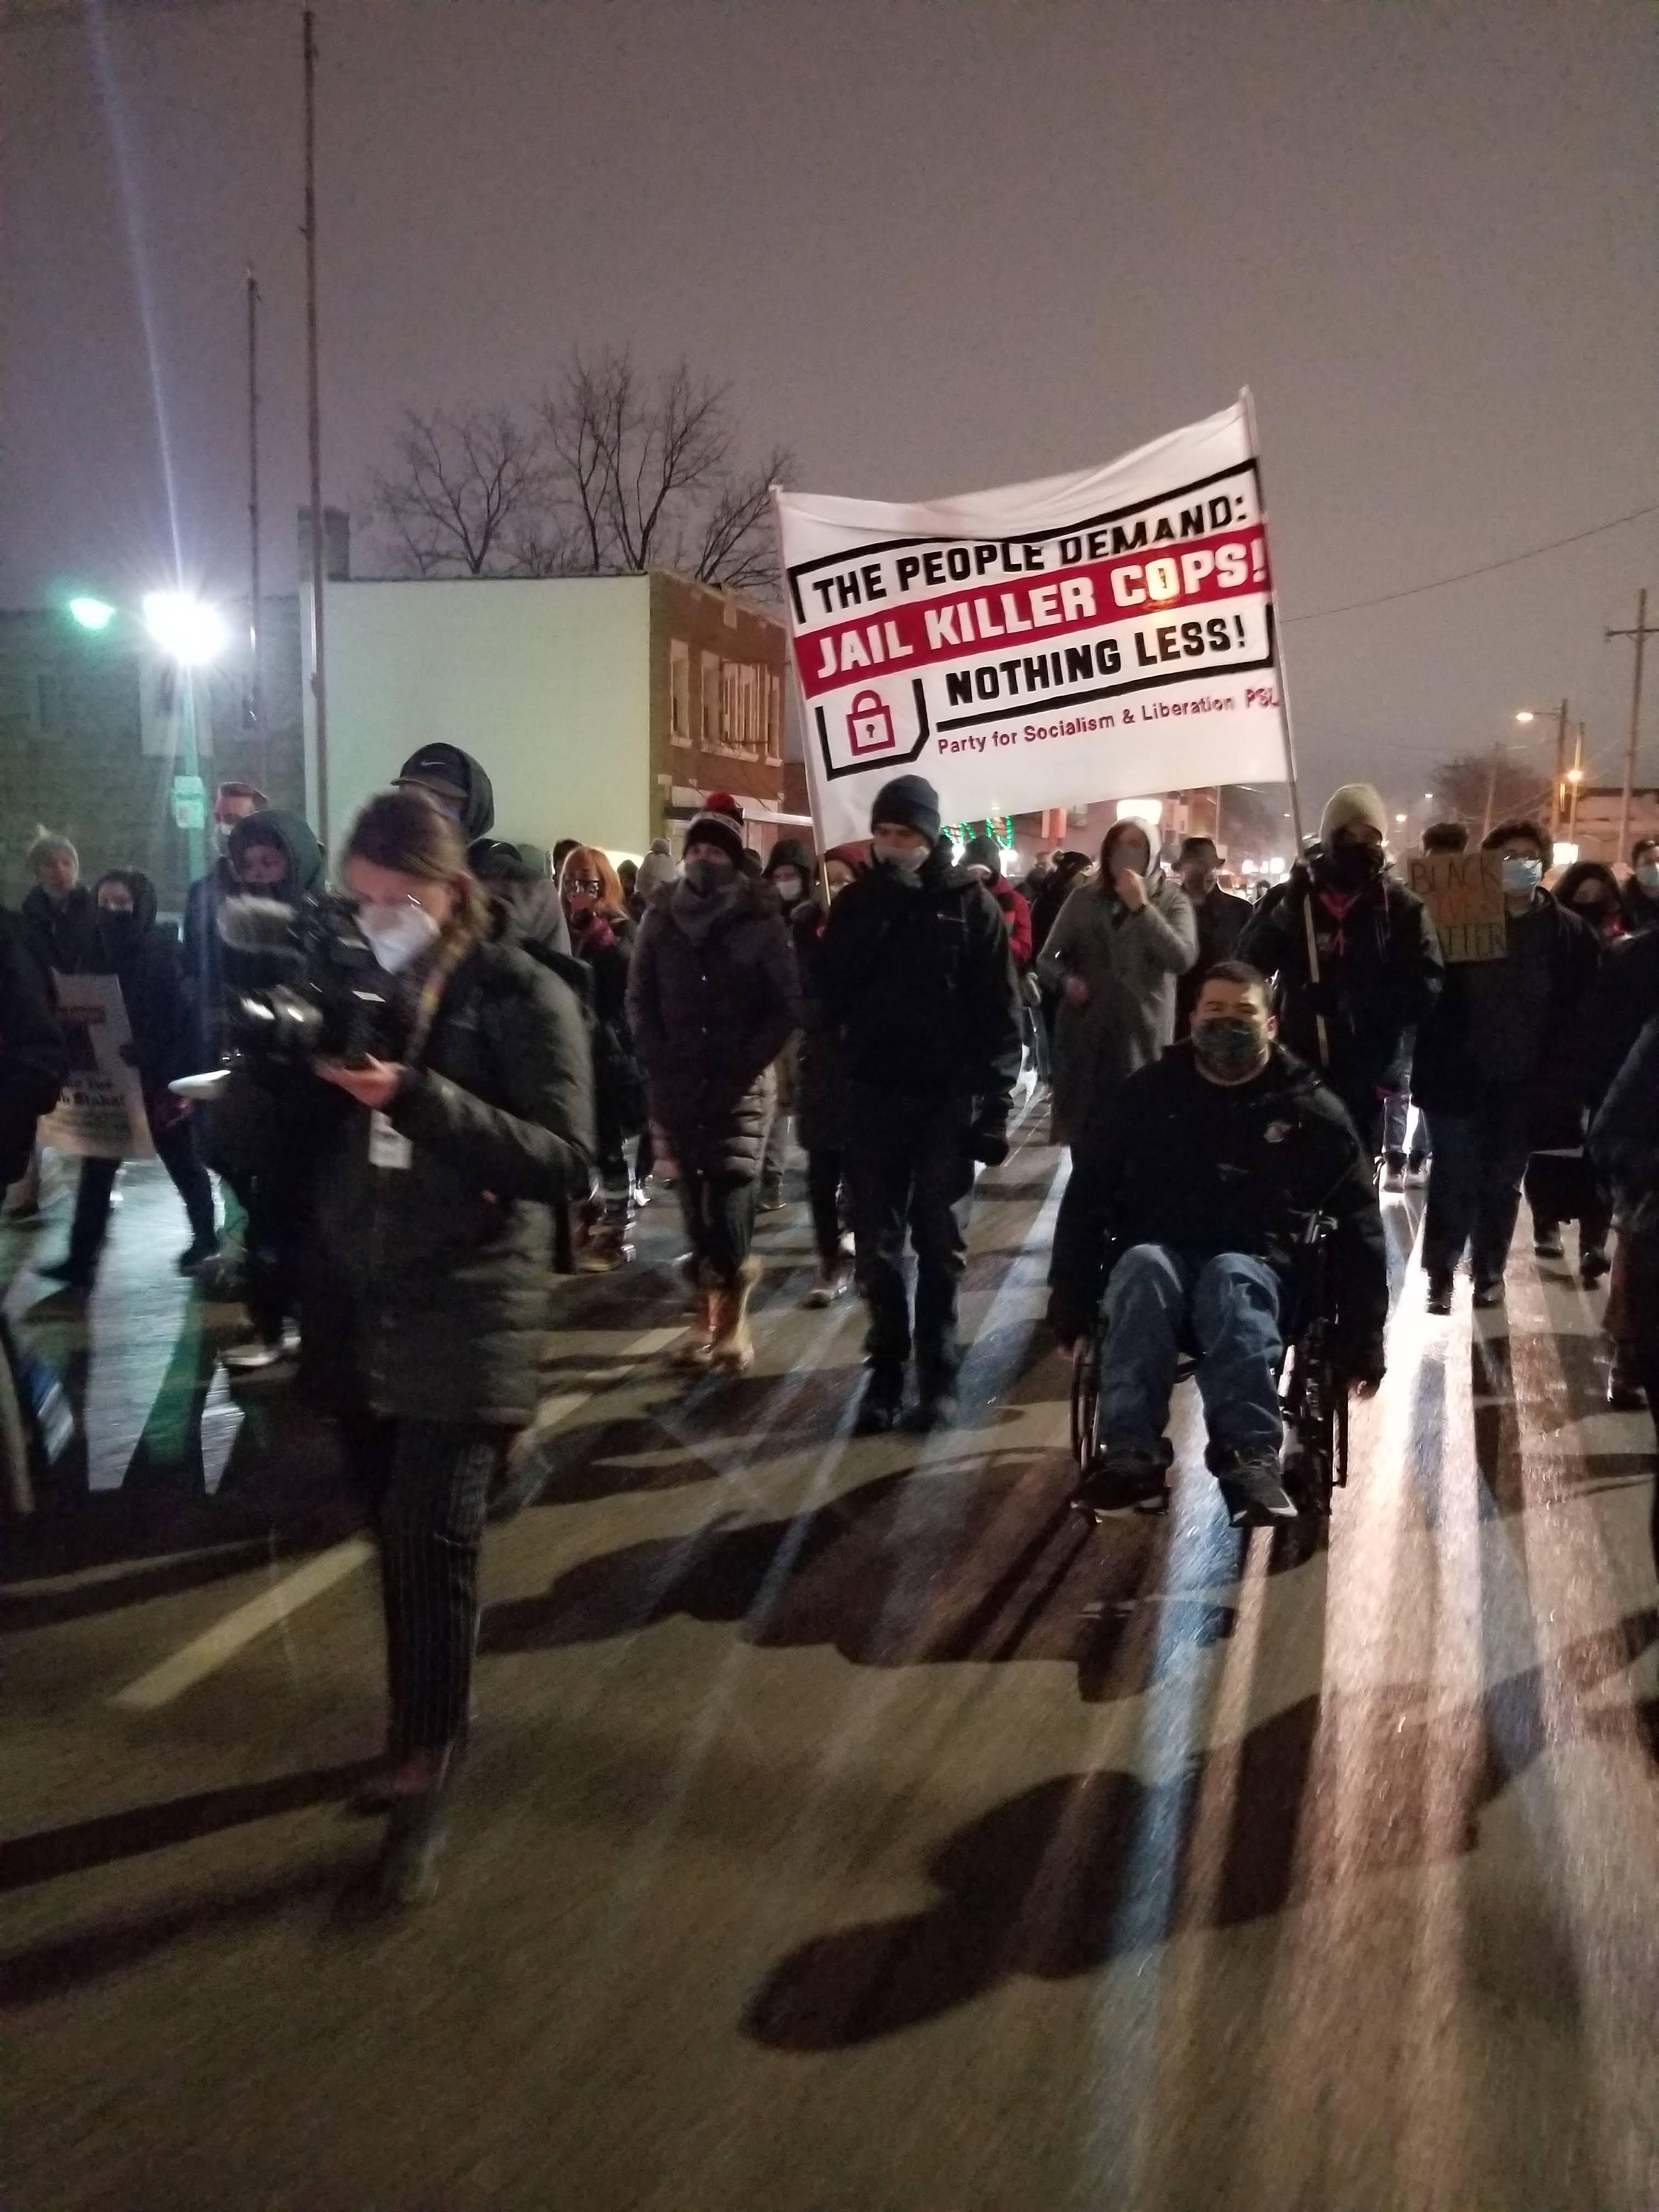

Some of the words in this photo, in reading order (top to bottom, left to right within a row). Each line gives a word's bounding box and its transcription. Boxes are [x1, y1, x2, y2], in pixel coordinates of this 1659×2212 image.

[812, 563, 887, 613] THE
[896, 541, 1045, 592] PEOPLE
[1059, 495, 1247, 565] DEMAND:
[816, 620, 913, 679] JAIL
[923, 577, 1097, 650] KILLER
[1110, 537, 1268, 607] COPS!
[945, 638, 1122, 706] NOTHING
[1134, 614, 1245, 667] LESS!
[938, 735, 986, 754] Party
[992, 731, 1018, 747] for
[1023, 715, 1115, 742] Socialism
[1122, 708, 1136, 724] &
[1141, 696, 1234, 721] Liberation
